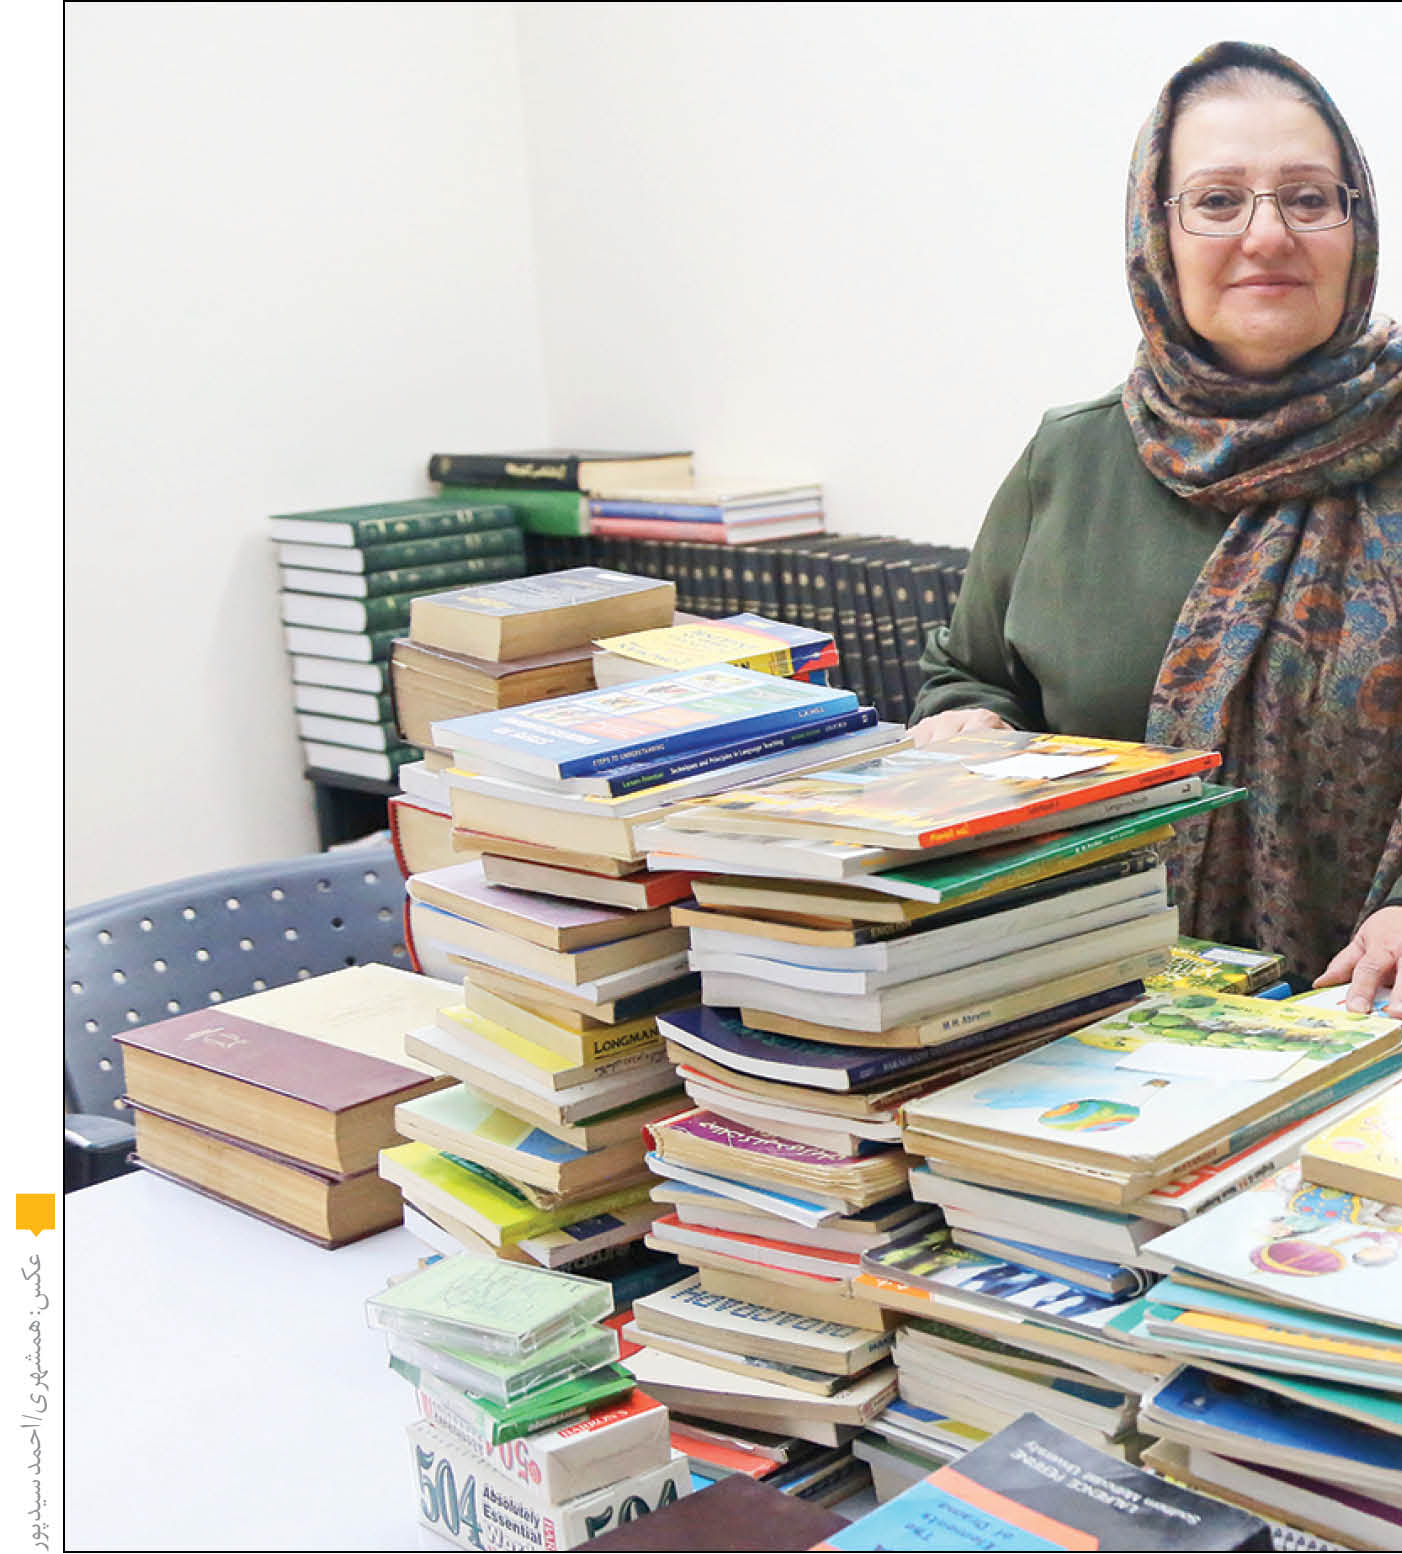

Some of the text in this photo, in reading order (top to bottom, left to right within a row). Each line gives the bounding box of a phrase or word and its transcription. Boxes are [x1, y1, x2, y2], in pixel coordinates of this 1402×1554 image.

[593, 1027, 660, 1056] LONGMAN
[416, 1444, 486, 1551] 504
[483, 1486, 541, 1528] Absolutely
[483, 1504, 542, 1546] Essential
